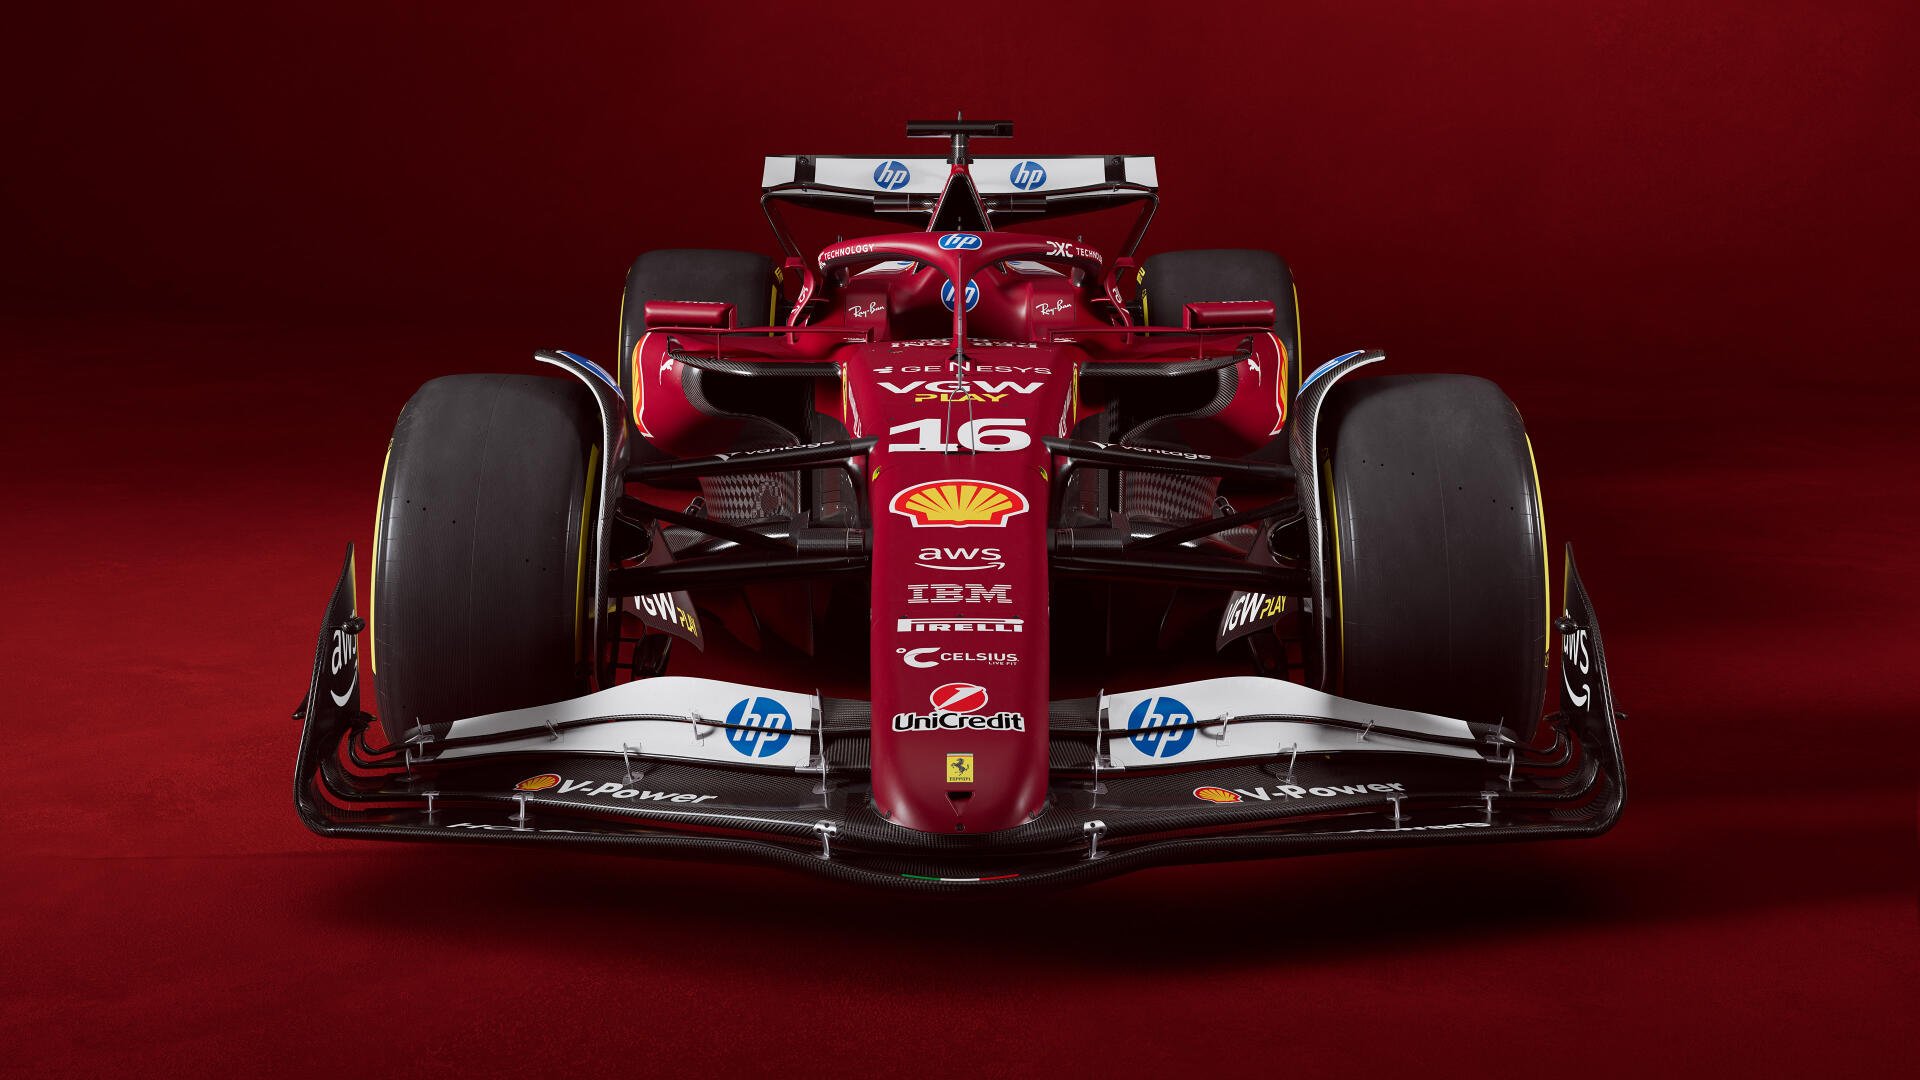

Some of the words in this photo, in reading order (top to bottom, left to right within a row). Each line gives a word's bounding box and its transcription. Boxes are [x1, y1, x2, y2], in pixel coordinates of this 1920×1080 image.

[876, 160, 908, 190] hp
[1013, 160, 1044, 190] hp
[943, 233, 978, 249] hp
[823, 243, 875, 260] TECHNOLOGY
[848, 301, 885, 318] Ray-Ban
[1035, 299, 1072, 315] Ray-Ban
[900, 361, 1052, 375] GENESYS
[876, 380, 1045, 394] VGW
[914, 393, 1009, 403] PLAY
[888, 418, 1032, 453] 16
[918, 547, 1002, 561] aws
[907, 584, 1013, 604] IBM
[1259, 595, 1288, 620] PLAY
[896, 618, 1025, 633] PIRELLI
[940, 652, 1018, 662] CELSIUS
[732, 697, 786, 758] hp
[894, 712, 1025, 731] UniCredit
[1135, 697, 1189, 758] hp
[556, 779, 718, 805] V-Power
[1235, 781, 1407, 802] V-Power
